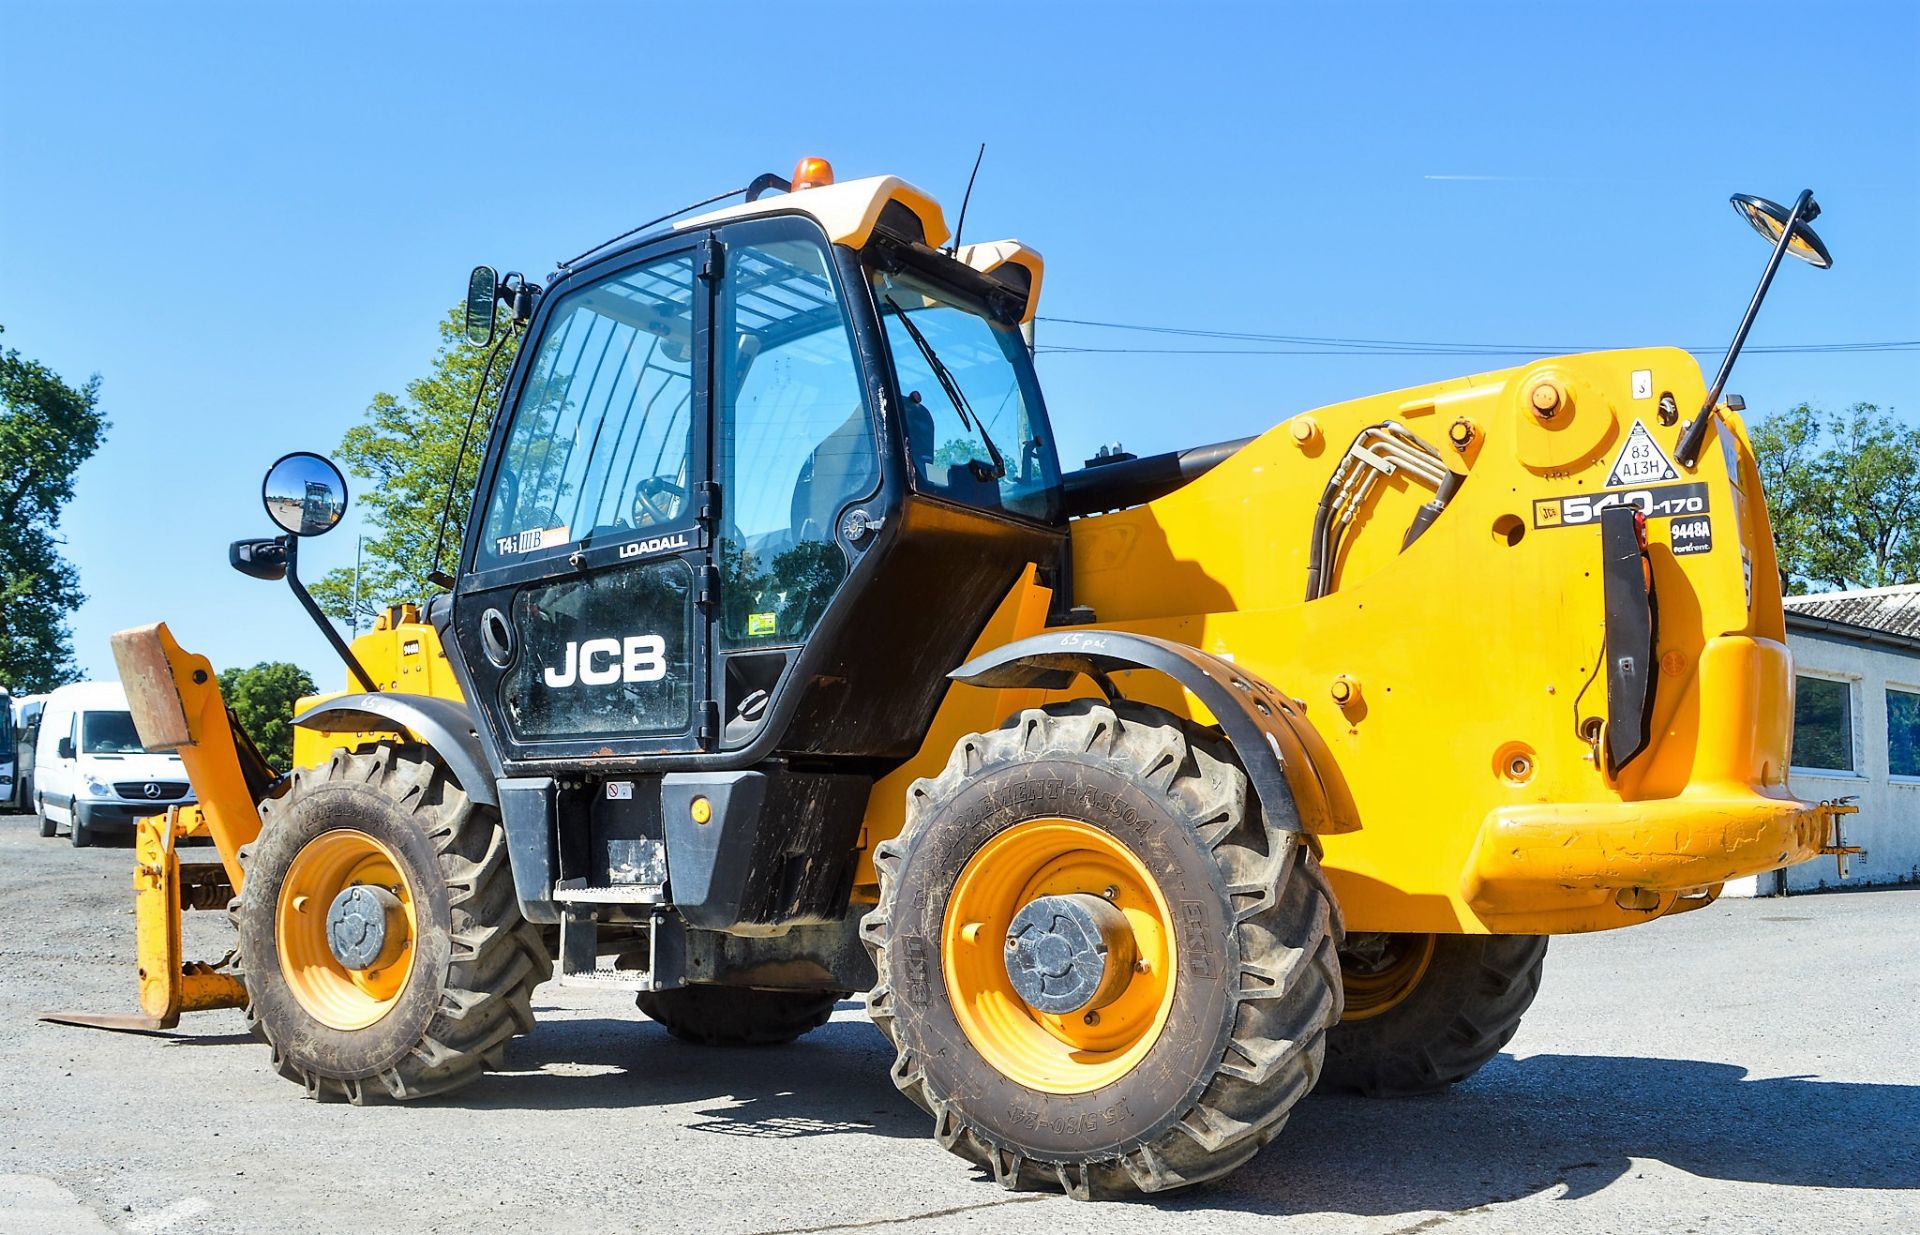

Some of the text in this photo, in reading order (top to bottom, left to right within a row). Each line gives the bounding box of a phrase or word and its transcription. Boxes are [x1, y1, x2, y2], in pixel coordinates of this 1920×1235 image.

[1631, 445, 1650, 459] 83
[1671, 521, 1711, 540] 9448A
[619, 534, 689, 559] LOADALL
[1060, 633, 1084, 646] 65
[544, 634, 667, 688] JCB
